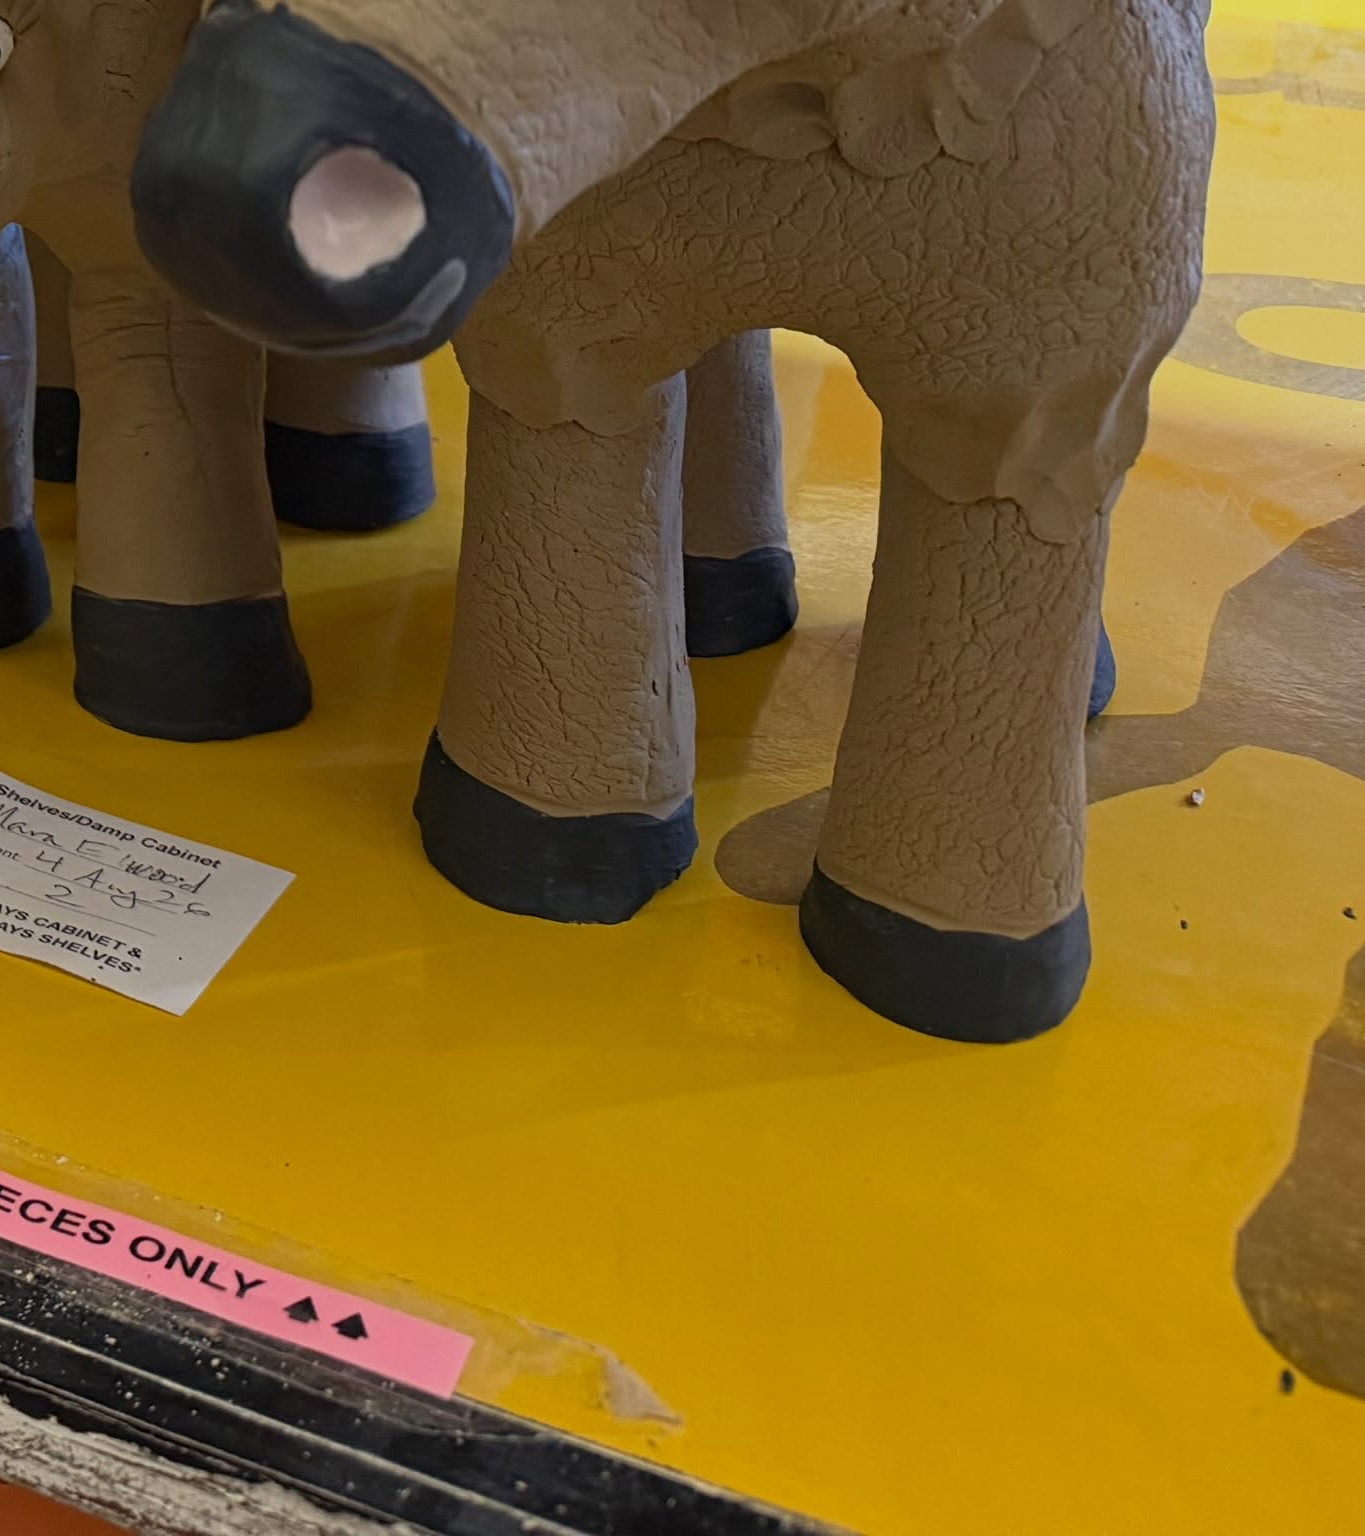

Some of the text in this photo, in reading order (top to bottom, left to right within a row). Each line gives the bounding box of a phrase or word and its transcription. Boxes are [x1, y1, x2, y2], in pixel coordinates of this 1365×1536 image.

[36, 850, 64, 873] 4
[141, 837, 221, 869] Cabinet
[45, 884, 86, 908] 2
[33, 916, 127, 951] CABINET
[127, 947, 142, 960] &
[129, 1236, 267, 1300] ONLY
